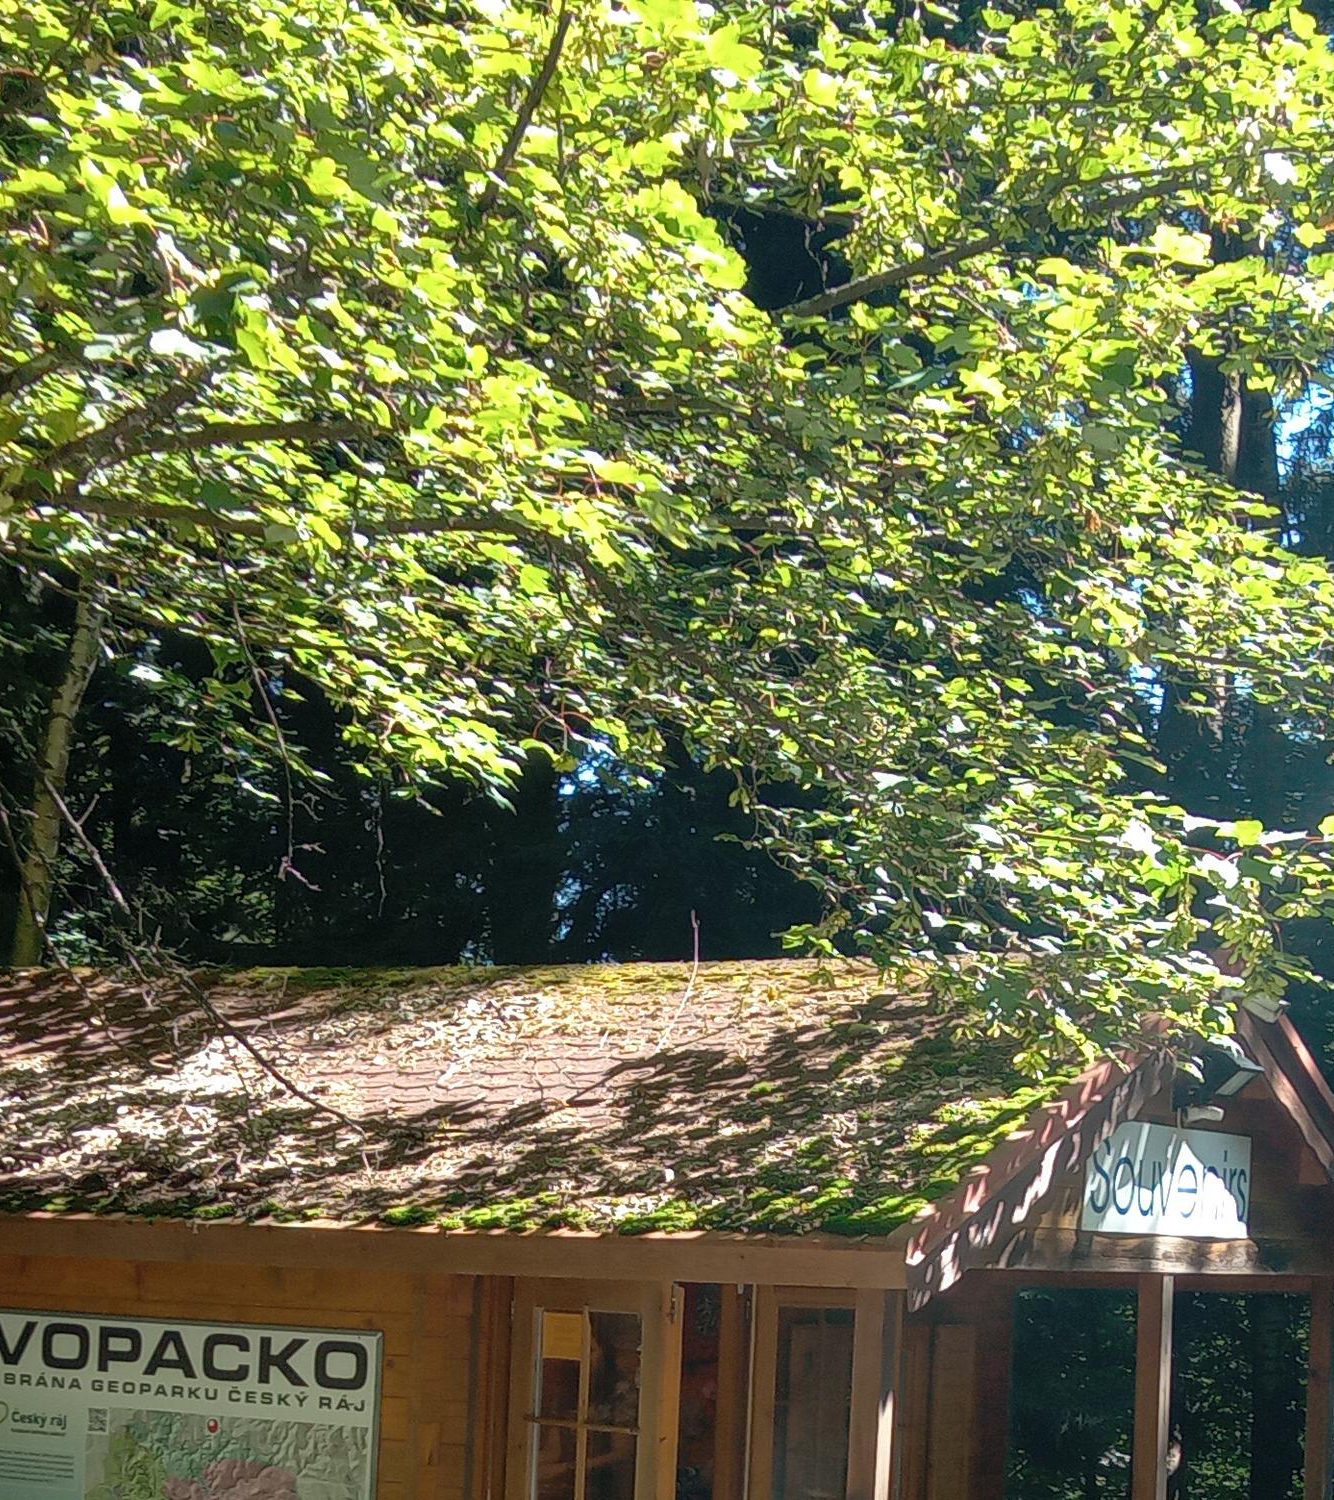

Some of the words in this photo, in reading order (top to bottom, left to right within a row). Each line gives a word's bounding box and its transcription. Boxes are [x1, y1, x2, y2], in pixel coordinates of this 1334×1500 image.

[4, 1372, 82, 1391] BRÁNA
[91, 1379, 218, 1401] GEOPARKU
[228, 1385, 309, 1408] ČESKÝ
[11, 1408, 48, 1428] Český
